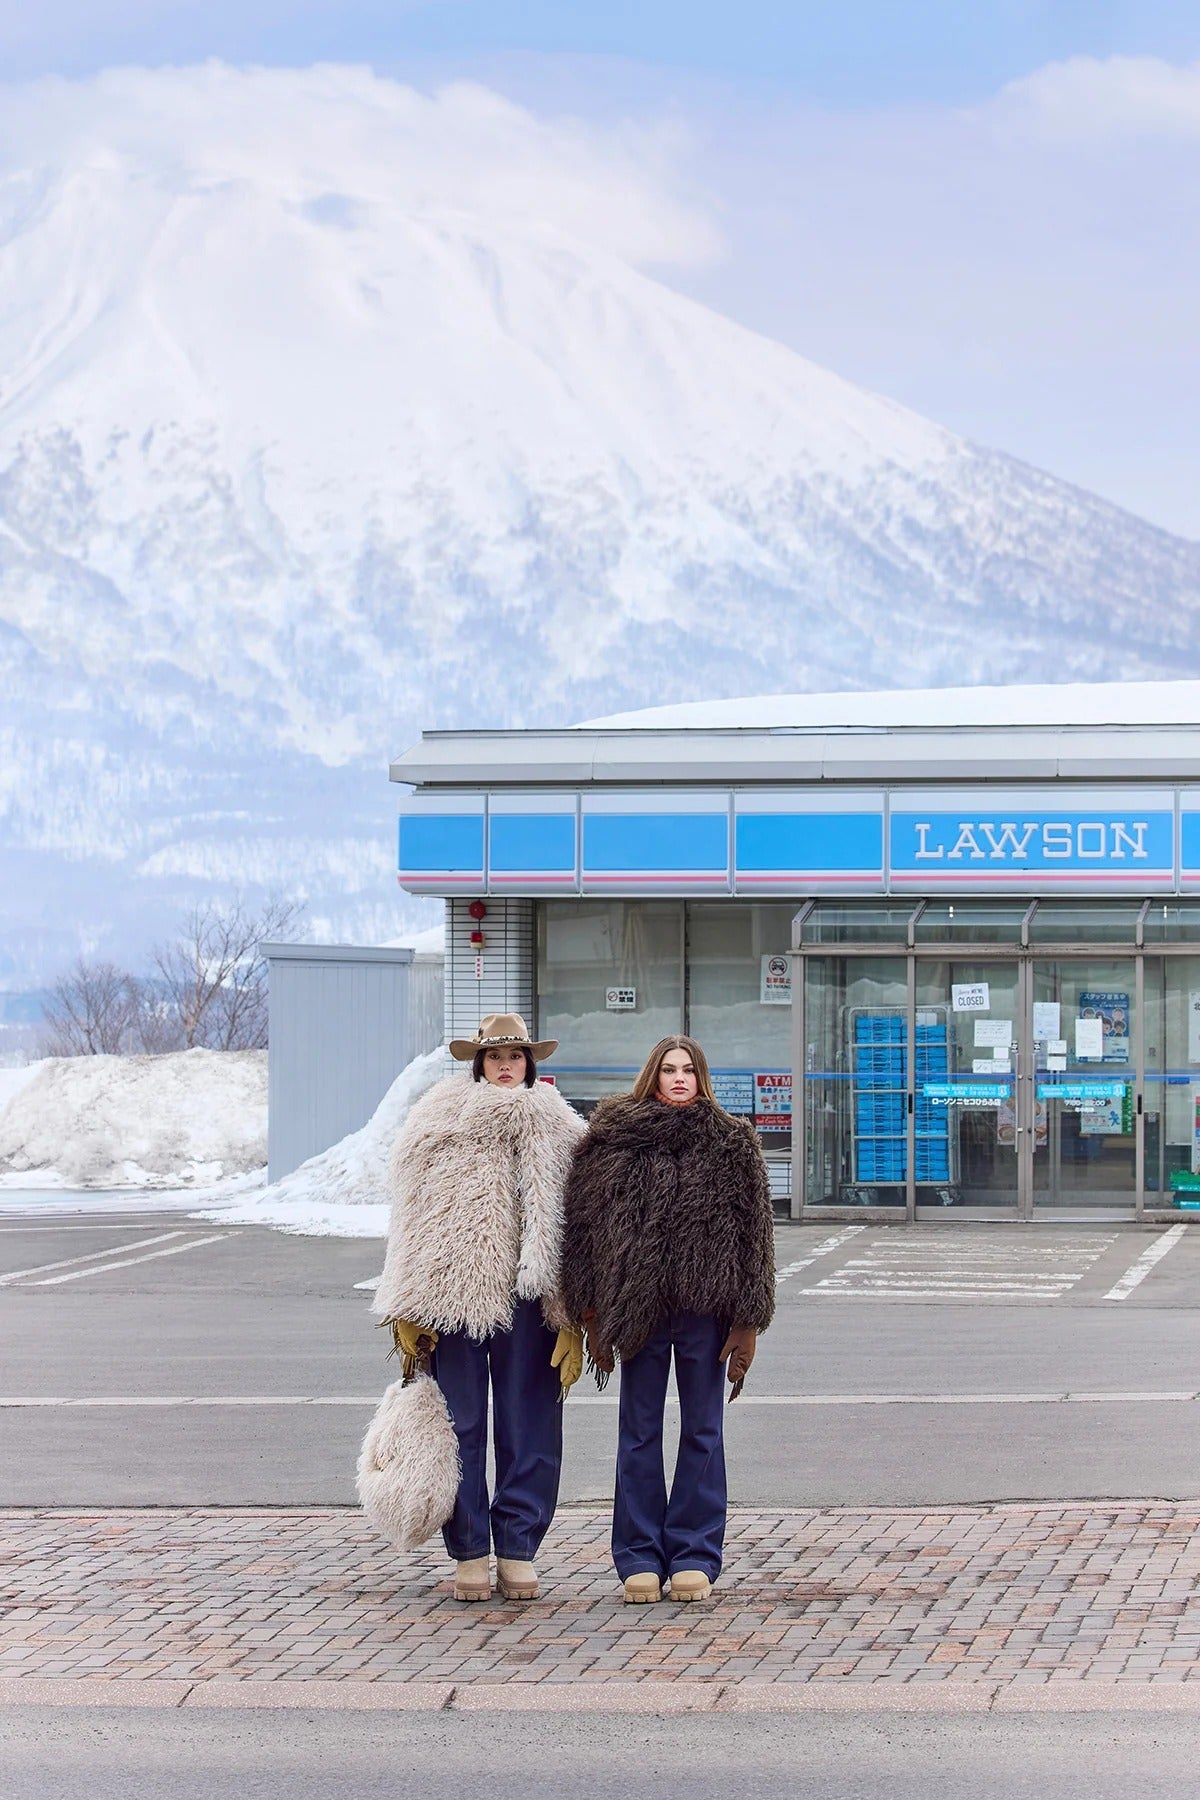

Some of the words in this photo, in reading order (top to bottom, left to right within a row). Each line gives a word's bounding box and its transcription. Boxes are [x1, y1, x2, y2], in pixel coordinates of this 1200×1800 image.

[915, 822, 1148, 858] LAWSON
[958, 996, 984, 1006] CLOSED
[764, 1077, 791, 1086] ATM
